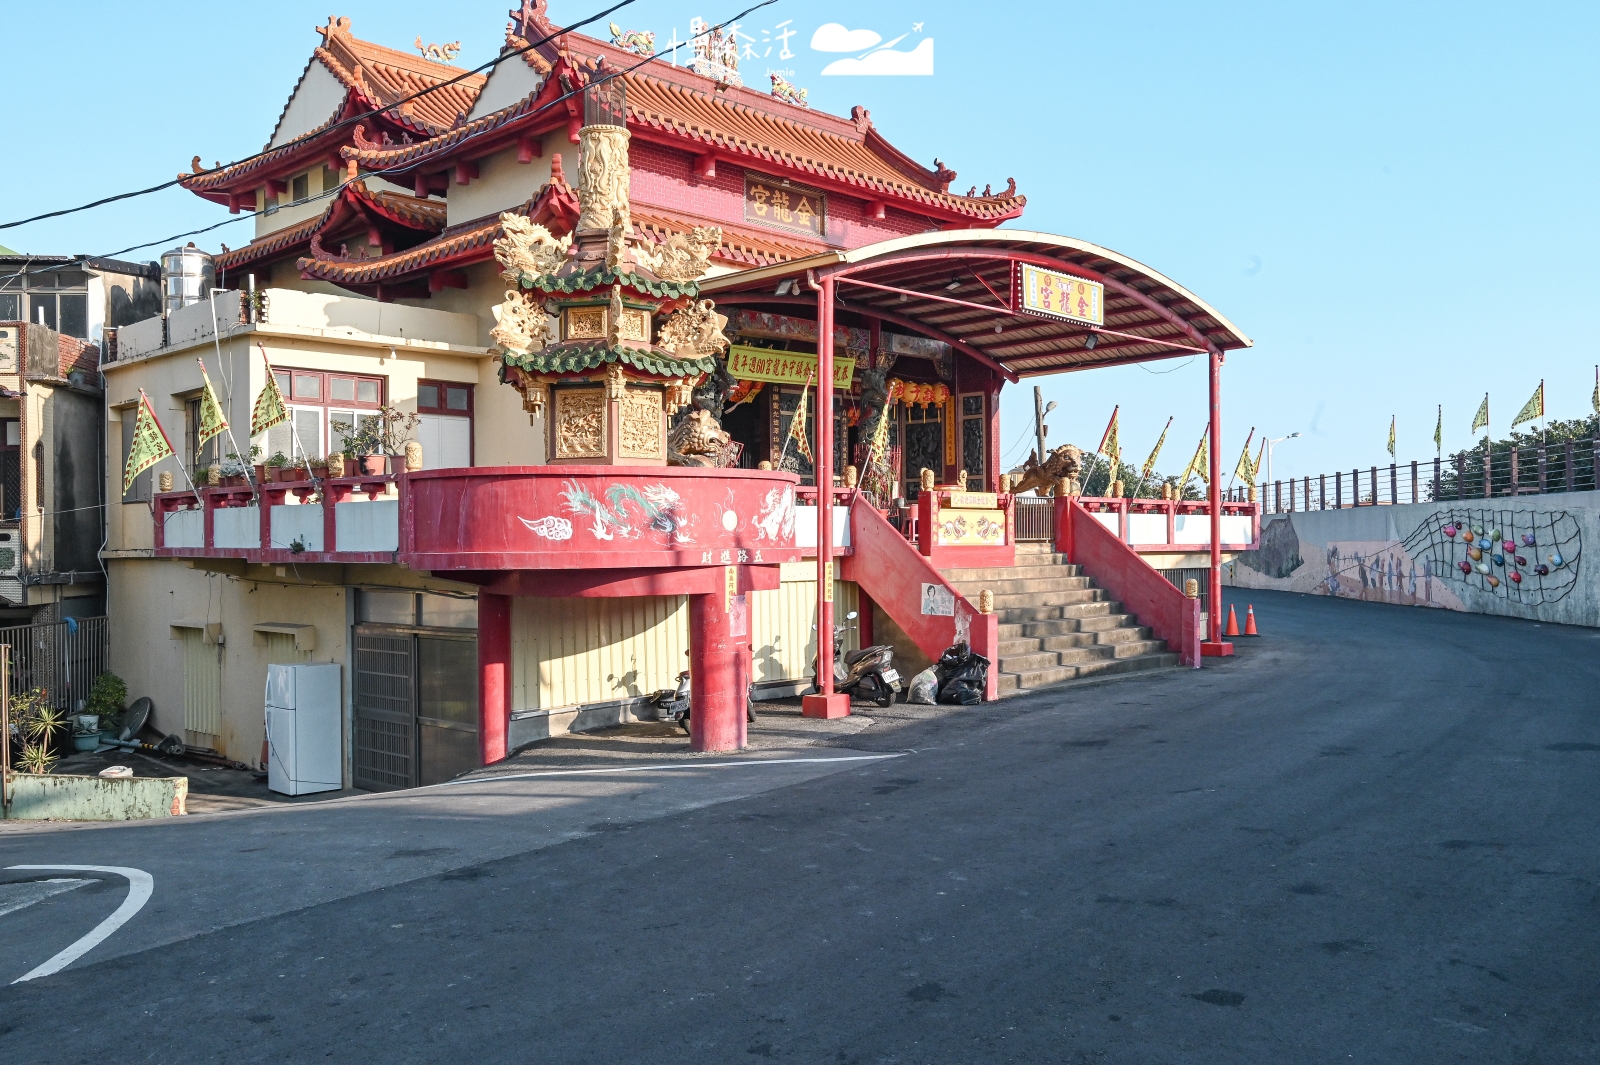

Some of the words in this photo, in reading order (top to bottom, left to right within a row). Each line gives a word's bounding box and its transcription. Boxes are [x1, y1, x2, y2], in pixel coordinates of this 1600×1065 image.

[750, 185, 815, 227] 金龍宮
[701, 549, 764, 565] 五路進財
